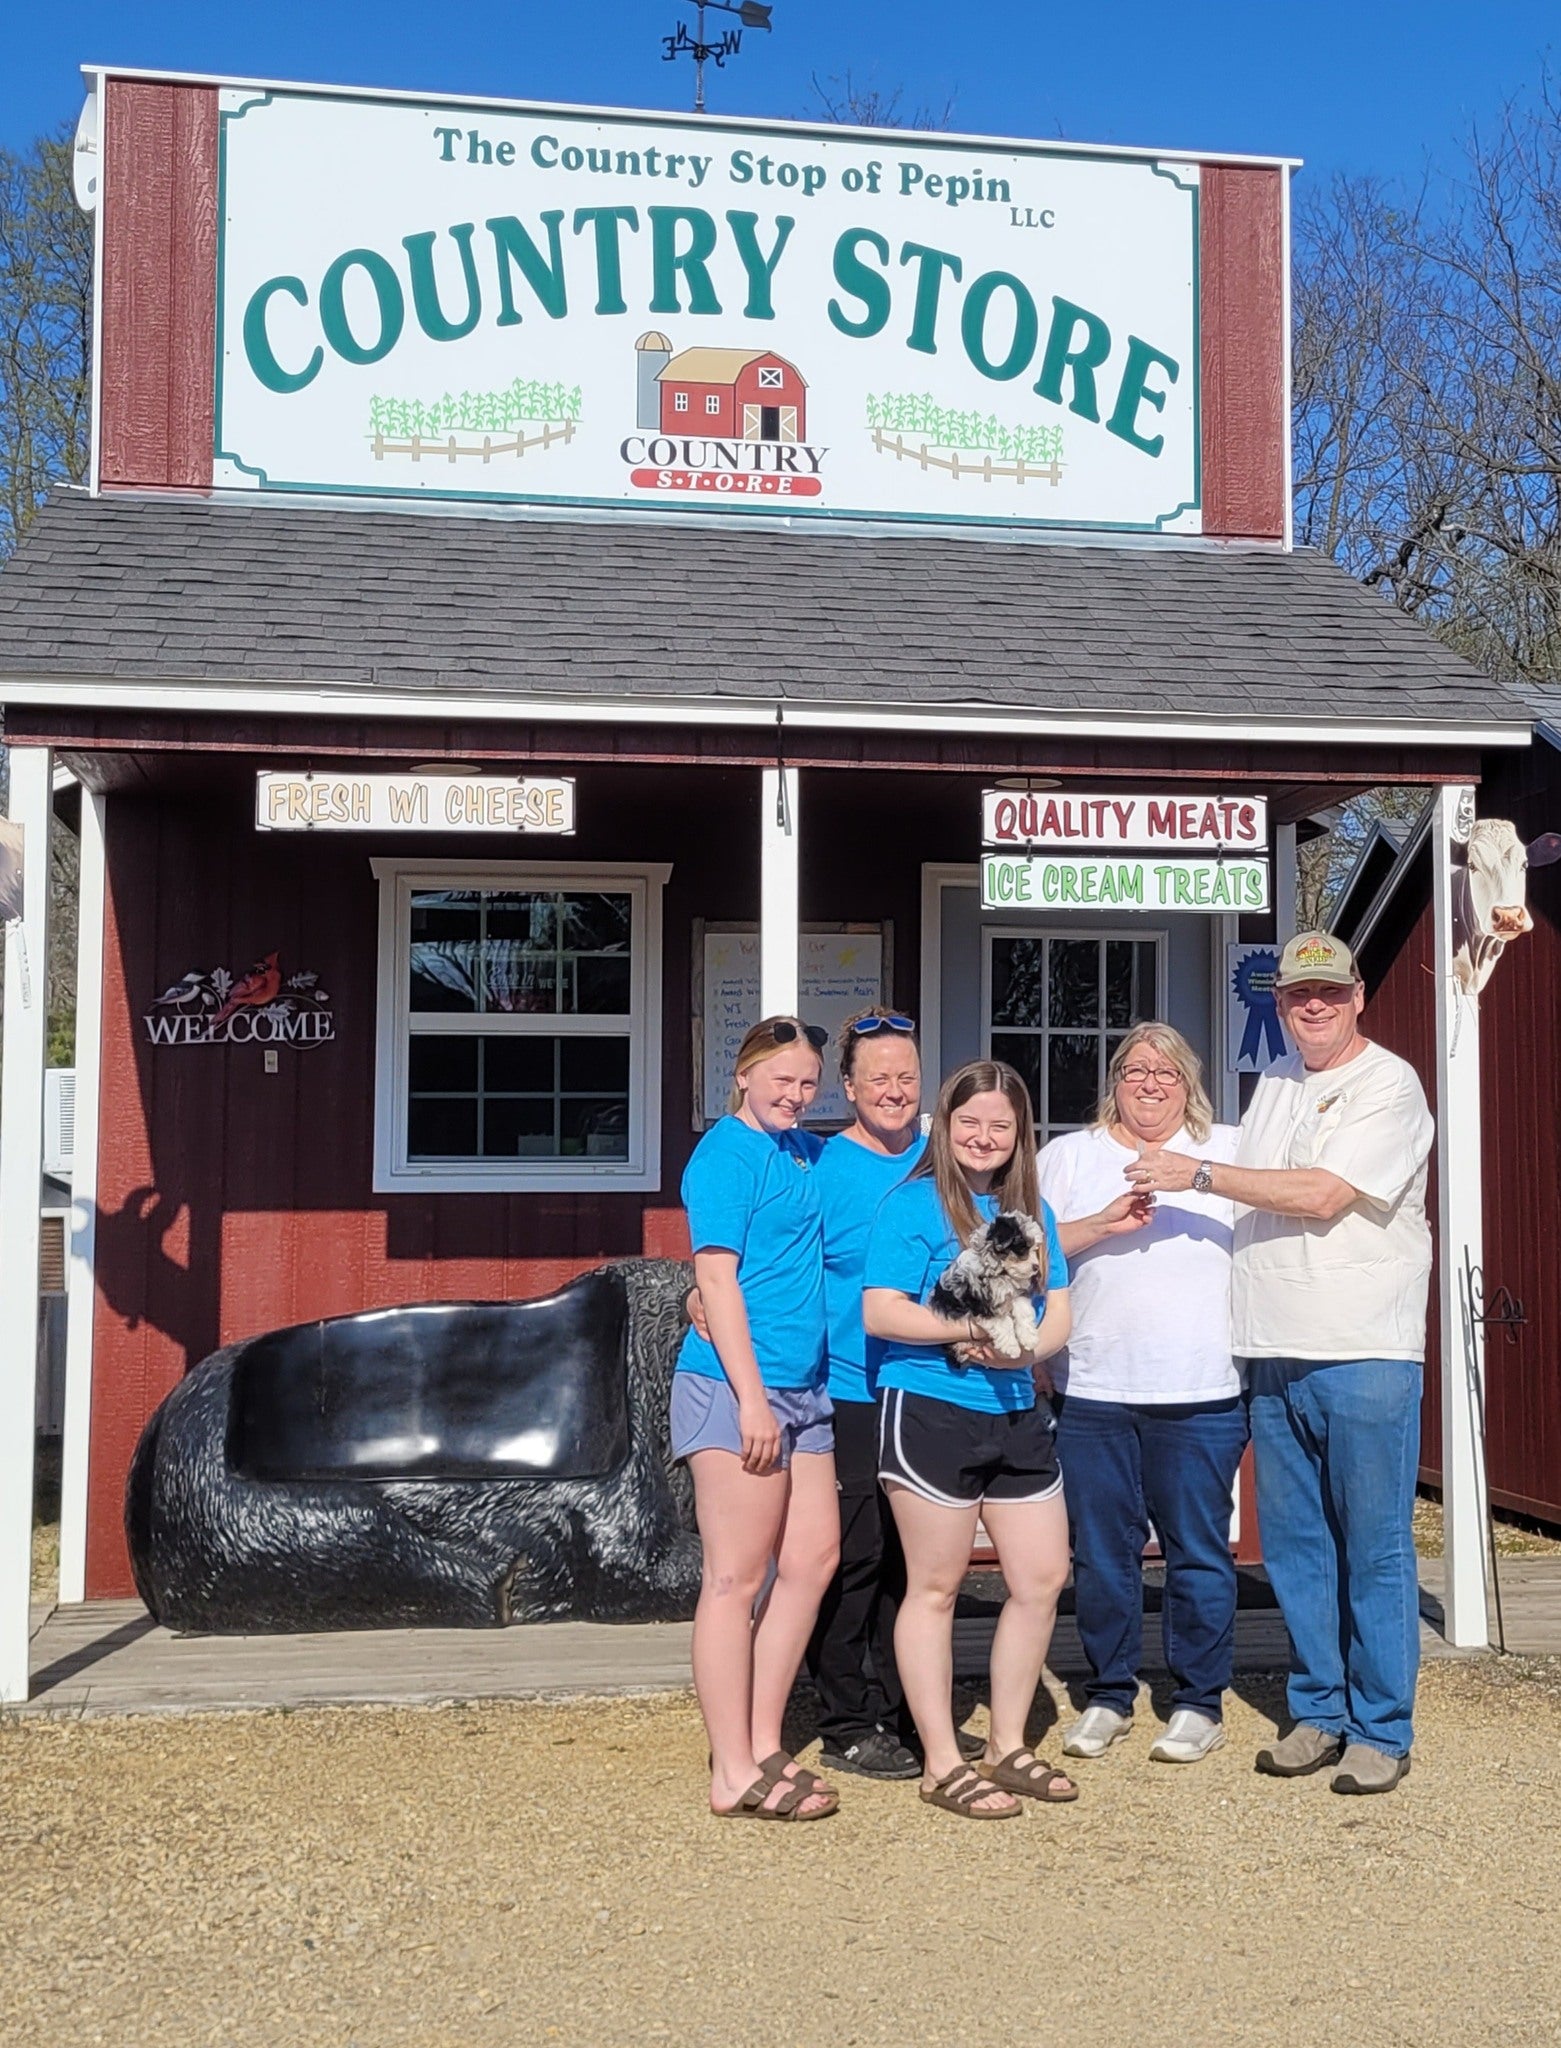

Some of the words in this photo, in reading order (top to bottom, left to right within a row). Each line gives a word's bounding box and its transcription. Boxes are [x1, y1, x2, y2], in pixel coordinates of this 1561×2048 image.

[433, 127, 516, 166] The
[530, 135, 713, 188] Country
[730, 150, 827, 197] Stop
[841, 161, 883, 194] of
[898, 162, 1012, 207] Pepin
[1010, 207, 1055, 229] LLC
[243, 205, 795, 394] COUNTRY
[827, 227, 1180, 458] STORE
[620, 436, 830, 474] COUNTRY
[268, 783, 371, 823] FRESH
[389, 783, 428, 823] WI
[445, 785, 564, 826] CHEESE
[995, 798, 1135, 841] QUALITY
[1148, 801, 1256, 840] MEATS
[988, 862, 1032, 901] ICE
[1042, 864, 1143, 903] CREAM
[1153, 866, 1263, 905] TREATS
[143, 1011, 335, 1045] WELCOME
